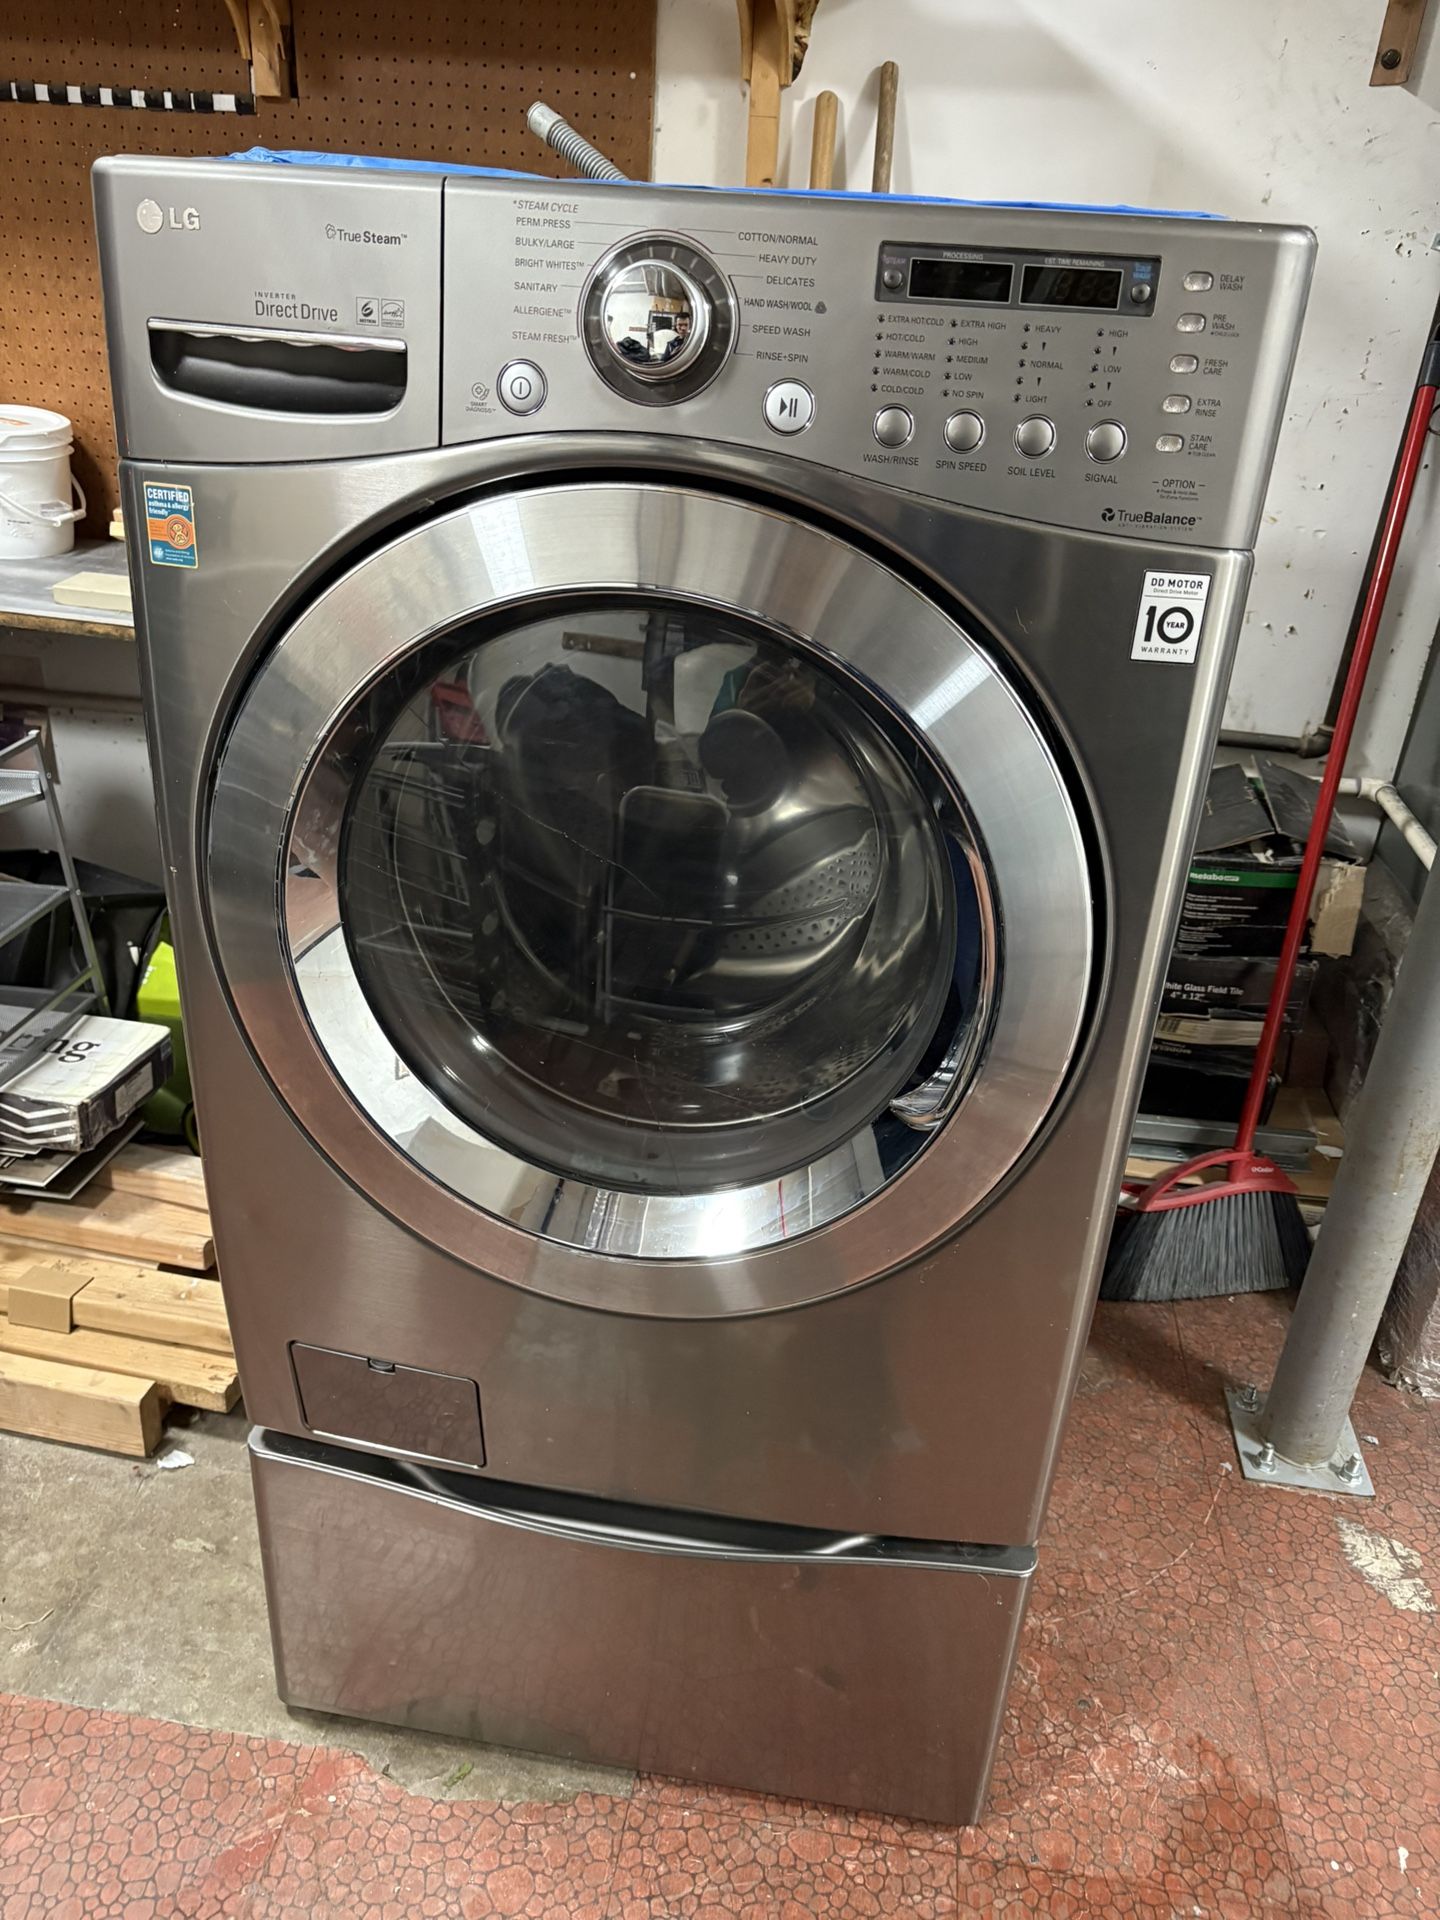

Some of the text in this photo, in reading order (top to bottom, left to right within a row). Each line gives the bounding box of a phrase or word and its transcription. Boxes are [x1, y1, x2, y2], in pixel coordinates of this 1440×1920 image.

[550, 202, 579, 213] CYCLE
[169, 207, 200, 231] LG
[515, 236, 575, 250] BULKY/LARGE
[738, 231, 818, 246] COTTON/NORMAL
[759, 254, 817, 266] HEAVY DUTY
[943, 251, 983, 260] PROCESSING
[515, 258, 544, 268] BRIGHT
[1071, 259, 1105, 267] REMAINING
[766, 275, 815, 288] DELICATES
[1220, 274, 1245, 283] DELAY
[514, 281, 558, 292] SANITARY
[1220, 283, 1243, 291] WASH
[255, 291, 296, 300] INVERTER
[744, 298, 812, 311] HAND WASH/WOOL
[255, 300, 338, 322] Direct Drive
[888, 315, 945, 327] EXTRA HOT/COLD
[1213, 313, 1227, 322] PRE
[752, 324, 811, 337] SPEED WASH
[960, 320, 1007, 331] EXTRA HIGH
[1035, 324, 1062, 334] HEAVY
[1212, 322, 1235, 330] WASH
[512, 330, 541, 341] STEAM
[886, 333, 925, 343] HOT/COLD
[1109, 329, 1129, 338] HIGH
[958, 338, 978, 346] HIGH
[756, 350, 809, 363] RINSE+SPIN
[884, 350, 936, 361] WARM/WARM
[956, 355, 989, 365] MEDIUM
[1030, 360, 1064, 370] NORMAL
[1205, 359, 1228, 368] FRESH
[882, 367, 931, 378] WARM/COLD
[1103, 365, 1122, 374] LOW
[1203, 367, 1222, 376] CARE
[953, 372, 973, 381] LOW
[881, 384, 925, 395] COLD/COLD
[952, 390, 984, 400] NO SPIN
[1025, 395, 1048, 403] LIGHT
[1097, 400, 1113, 408] OFF
[1197, 398, 1221, 407] EXTRA
[1195, 408, 1217, 418] RINSE
[1190, 434, 1213, 443] STAIN
[1188, 442, 1208, 451] CARE
[863, 453, 919, 466] WASH/RINSE
[935, 459, 987, 472] SPIN SPEED
[1007, 465, 1056, 479] SOIL LEVEL
[1084, 472, 1118, 485] SIGNAL
[1162, 478, 1196, 489] OPTION
[147, 487, 189, 503] CERTIFIED
[1151, 577, 1204, 590] DD MOTOR
[1143, 605, 1195, 645] 10
[1166, 621, 1185, 629] YEAR
[1141, 646, 1190, 656] WARRANTY
[1184, 983, 1205, 993] Glass
[1207, 985, 1228, 994] Field
[1230, 987, 1244, 996] Tile
